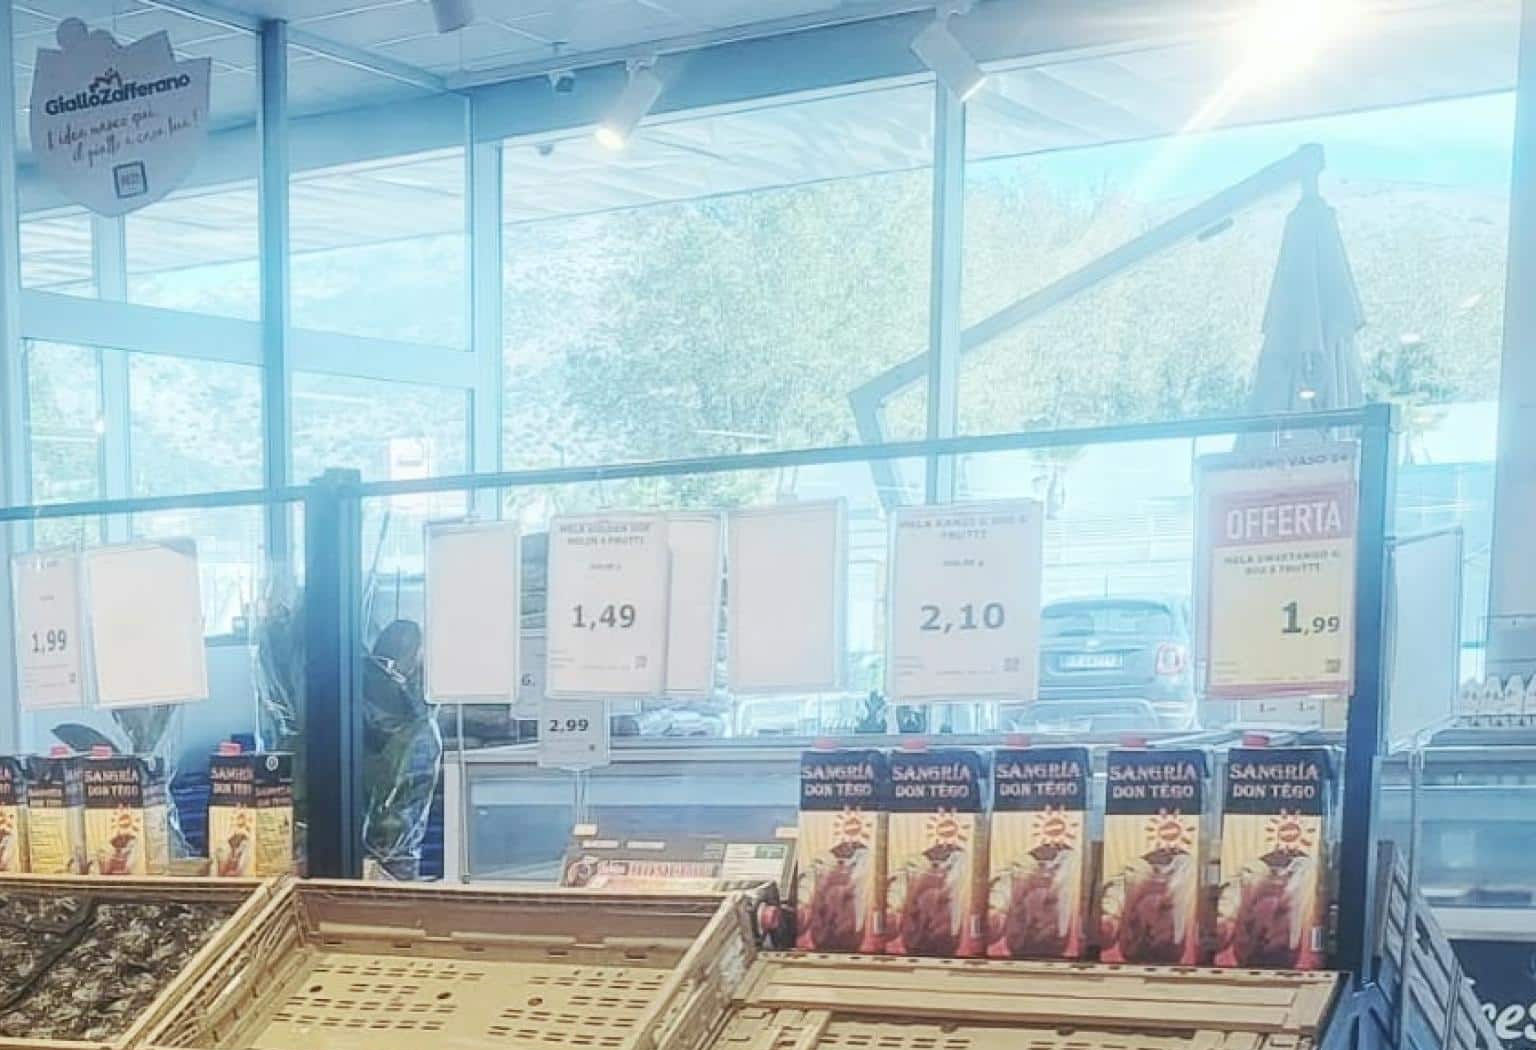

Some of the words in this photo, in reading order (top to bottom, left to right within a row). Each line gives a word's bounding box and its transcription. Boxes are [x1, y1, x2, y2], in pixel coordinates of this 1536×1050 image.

[46, 73, 191, 115] GialloZafferano
[1226, 501, 1342, 540] OFFERTA
[572, 604, 637, 631] 1,49
[920, 602, 1005, 634] 2,10
[1282, 600, 1340, 636] 1,99
[31, 629, 68, 655] 1,99
[1113, 785, 1144, 799] DON
[1233, 784, 1266, 798] DON
